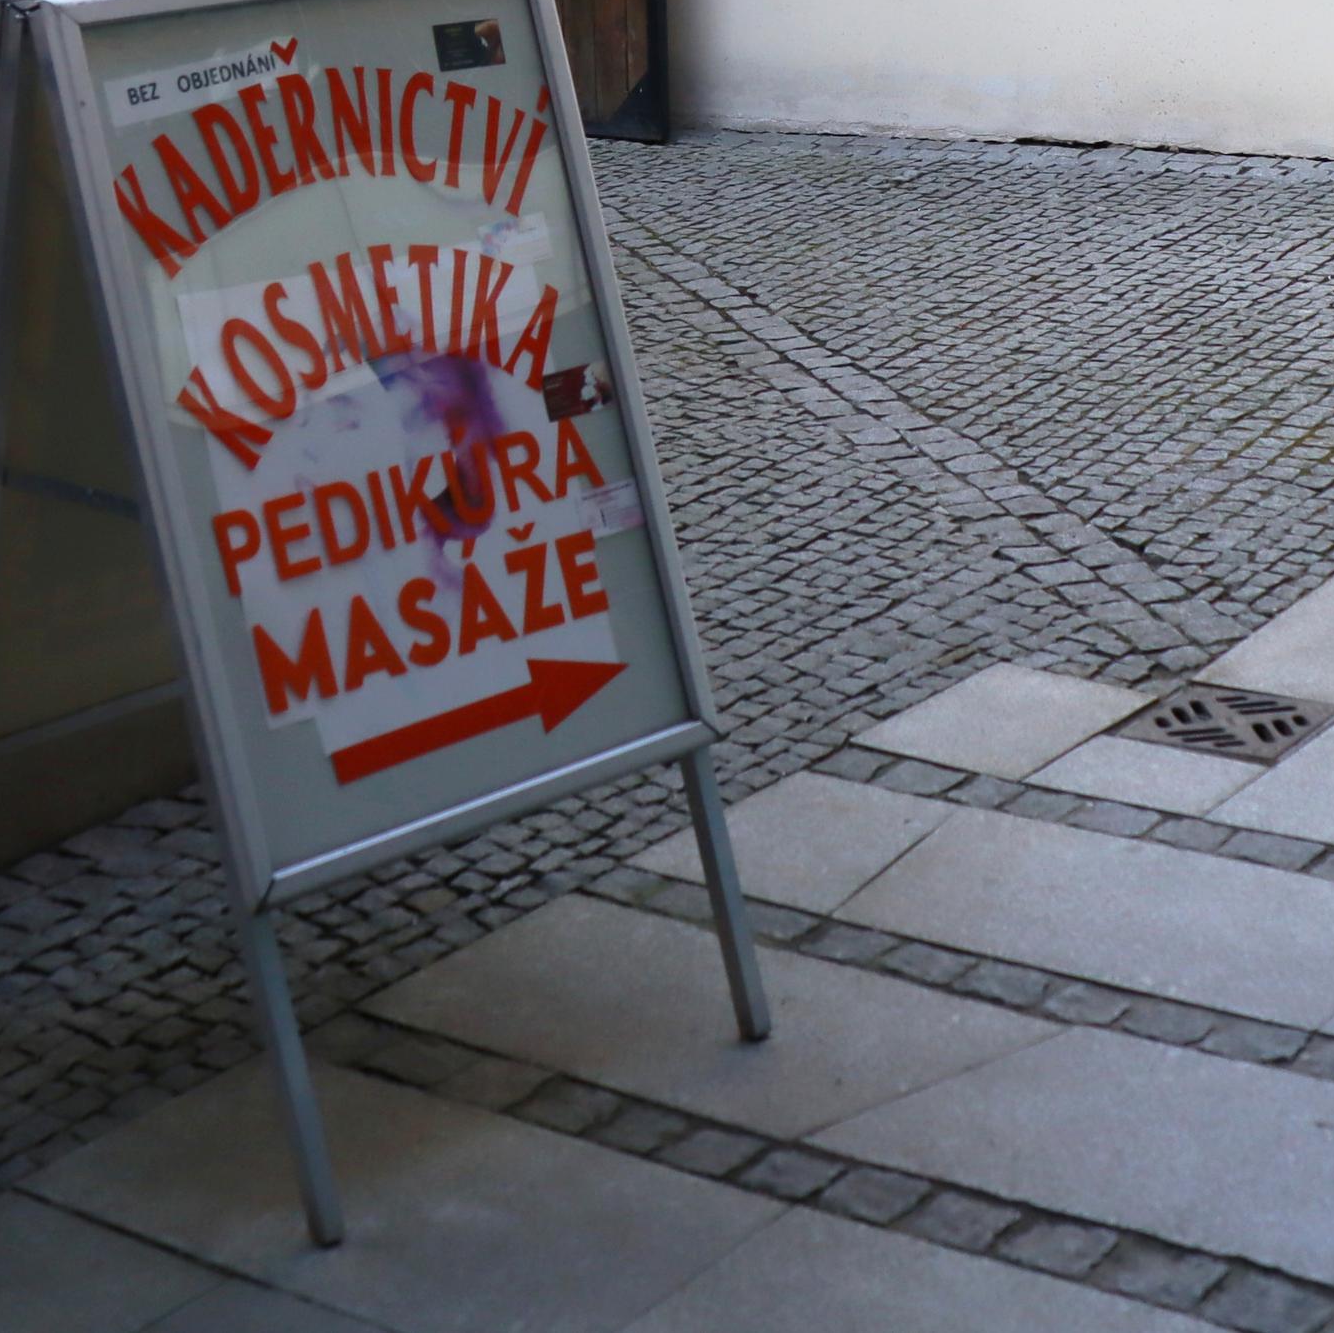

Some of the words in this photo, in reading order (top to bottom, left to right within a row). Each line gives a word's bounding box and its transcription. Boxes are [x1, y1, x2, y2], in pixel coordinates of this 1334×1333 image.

[113, 37, 552, 280] KADEŘNICTVÍ
[127, 82, 161, 106] BEZ
[176, 243, 559, 470] KOSMETIKA
[212, 417, 605, 598] PEDIKÚRA
[252, 521, 610, 716] MASÁŽE
